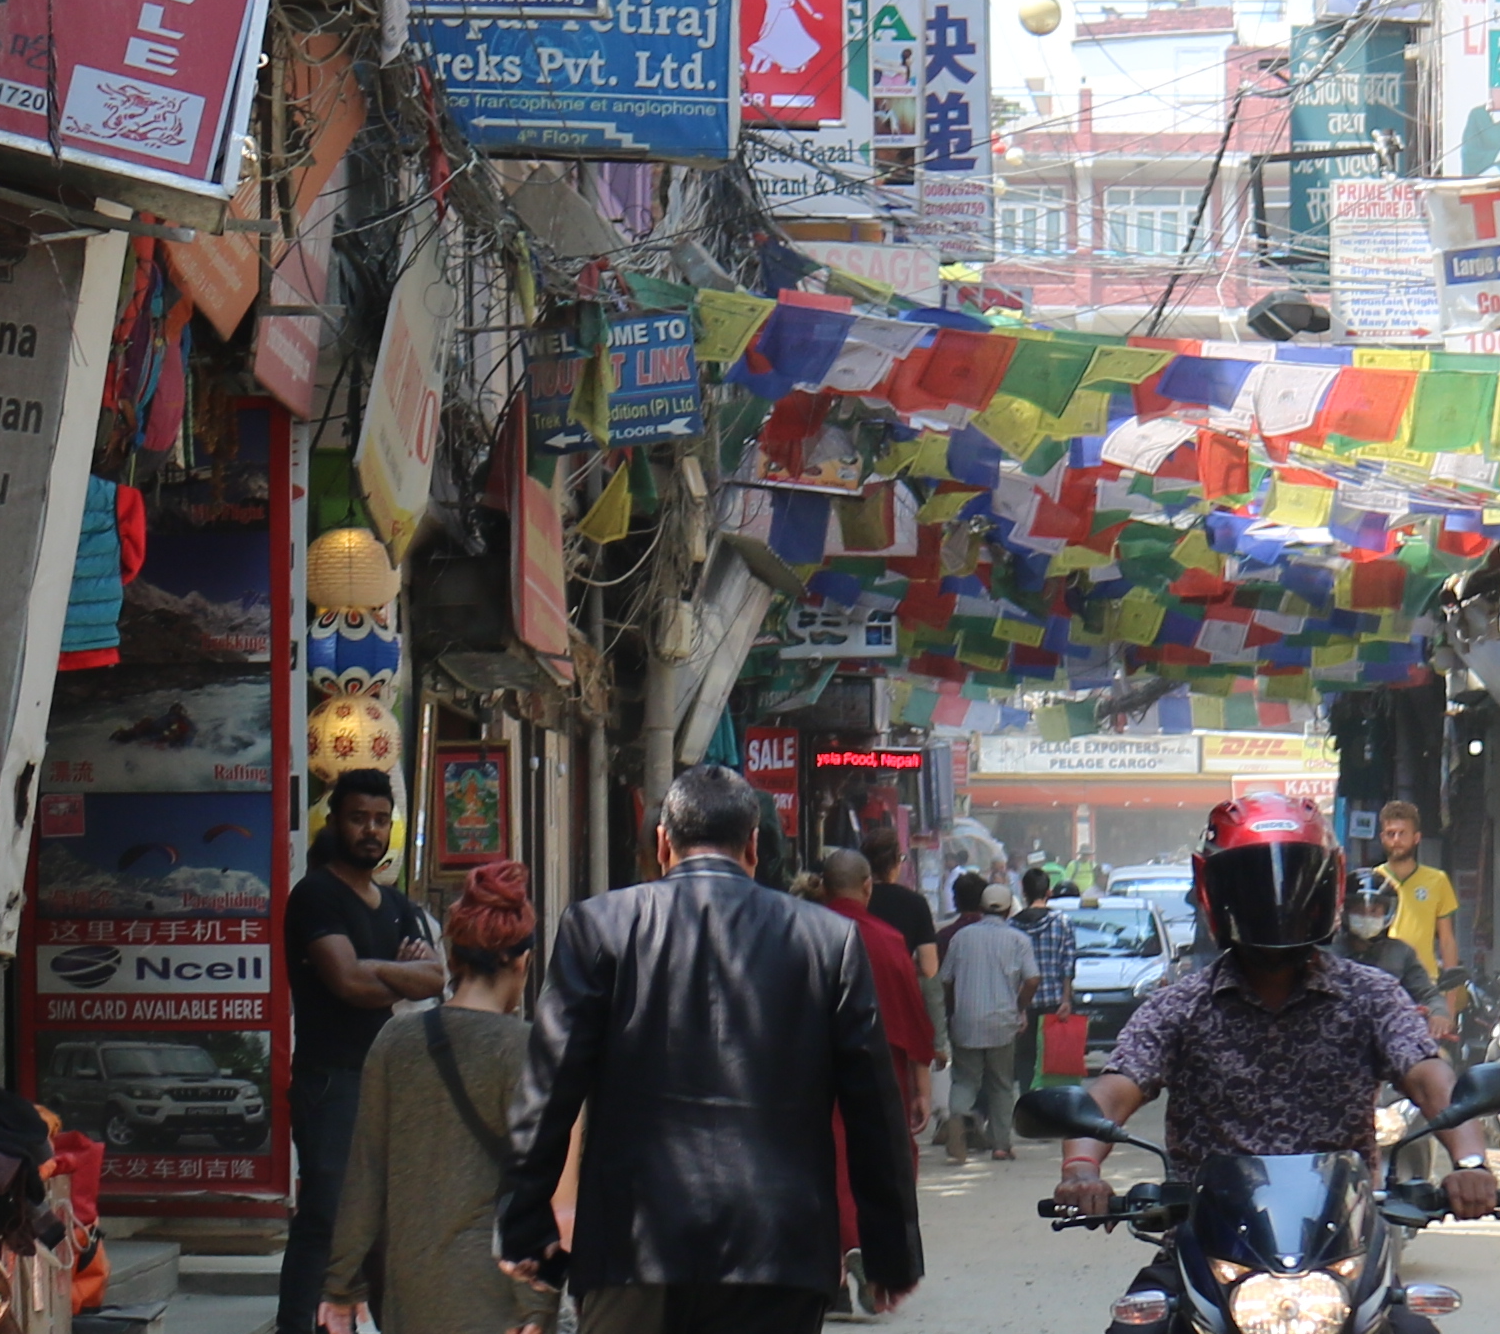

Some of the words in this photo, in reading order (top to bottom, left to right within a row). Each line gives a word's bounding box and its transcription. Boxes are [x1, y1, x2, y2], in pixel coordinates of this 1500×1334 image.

[536, 49, 618, 86] Pvt.
[635, 52, 716, 90] Ltd.
[476, 95, 584, 112] francophone
[591, 99, 607, 111] et
[613, 101, 716, 117] anglophone
[517, 130, 537, 142] 4th
[543, 131, 588, 145] Floor
[801, 139, 854, 163] Gazal
[1337, 184, 1387, 200] PRIME
[1337, 201, 1399, 217] ADVENTURE
[1452, 250, 1494, 277] Large
[654, 319, 686, 341] TO
[636, 345, 691, 386] LINK
[650, 400, 669, 415] (P)
[673, 397, 697, 413] Ltd.
[749, 737, 795, 771] SALE
[1030, 742, 1081, 755] PELAGE
[1084, 742, 1159, 754] EXPORTERS
[1219, 738, 1288, 756] DHL
[213, 762, 269, 785] Rafting
[1050, 758, 1104, 769] PELAGE
[49, 919, 264, 944] 这里有手机卡
[135, 955, 264, 983] Ncell
[47, 998, 82, 1021] SIM
[85, 998, 129, 1021] CARD
[133, 997, 217, 1021] AVAILABLE
[221, 998, 264, 1021] HERE
